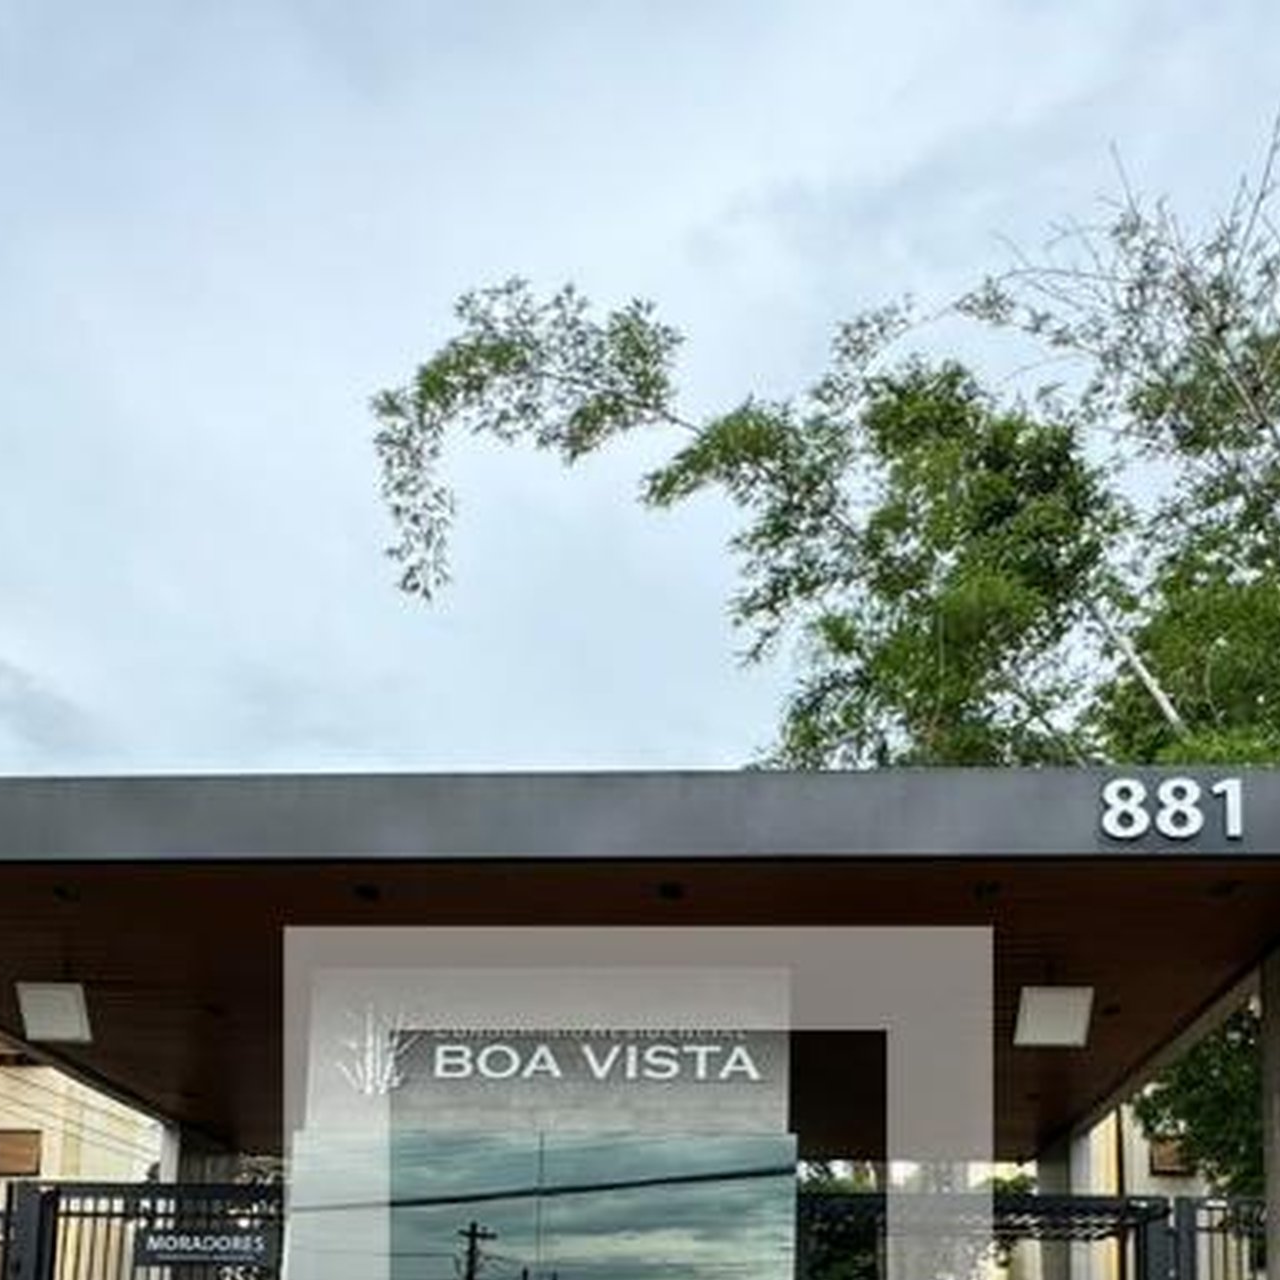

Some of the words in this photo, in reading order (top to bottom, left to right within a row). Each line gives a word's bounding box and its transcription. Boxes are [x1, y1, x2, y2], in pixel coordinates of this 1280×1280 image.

[1102, 777, 1242, 838] 881
[433, 1044, 563, 1079] BOA
[581, 1044, 761, 1081] VISTA
[146, 1235, 265, 1251] MORADORES
